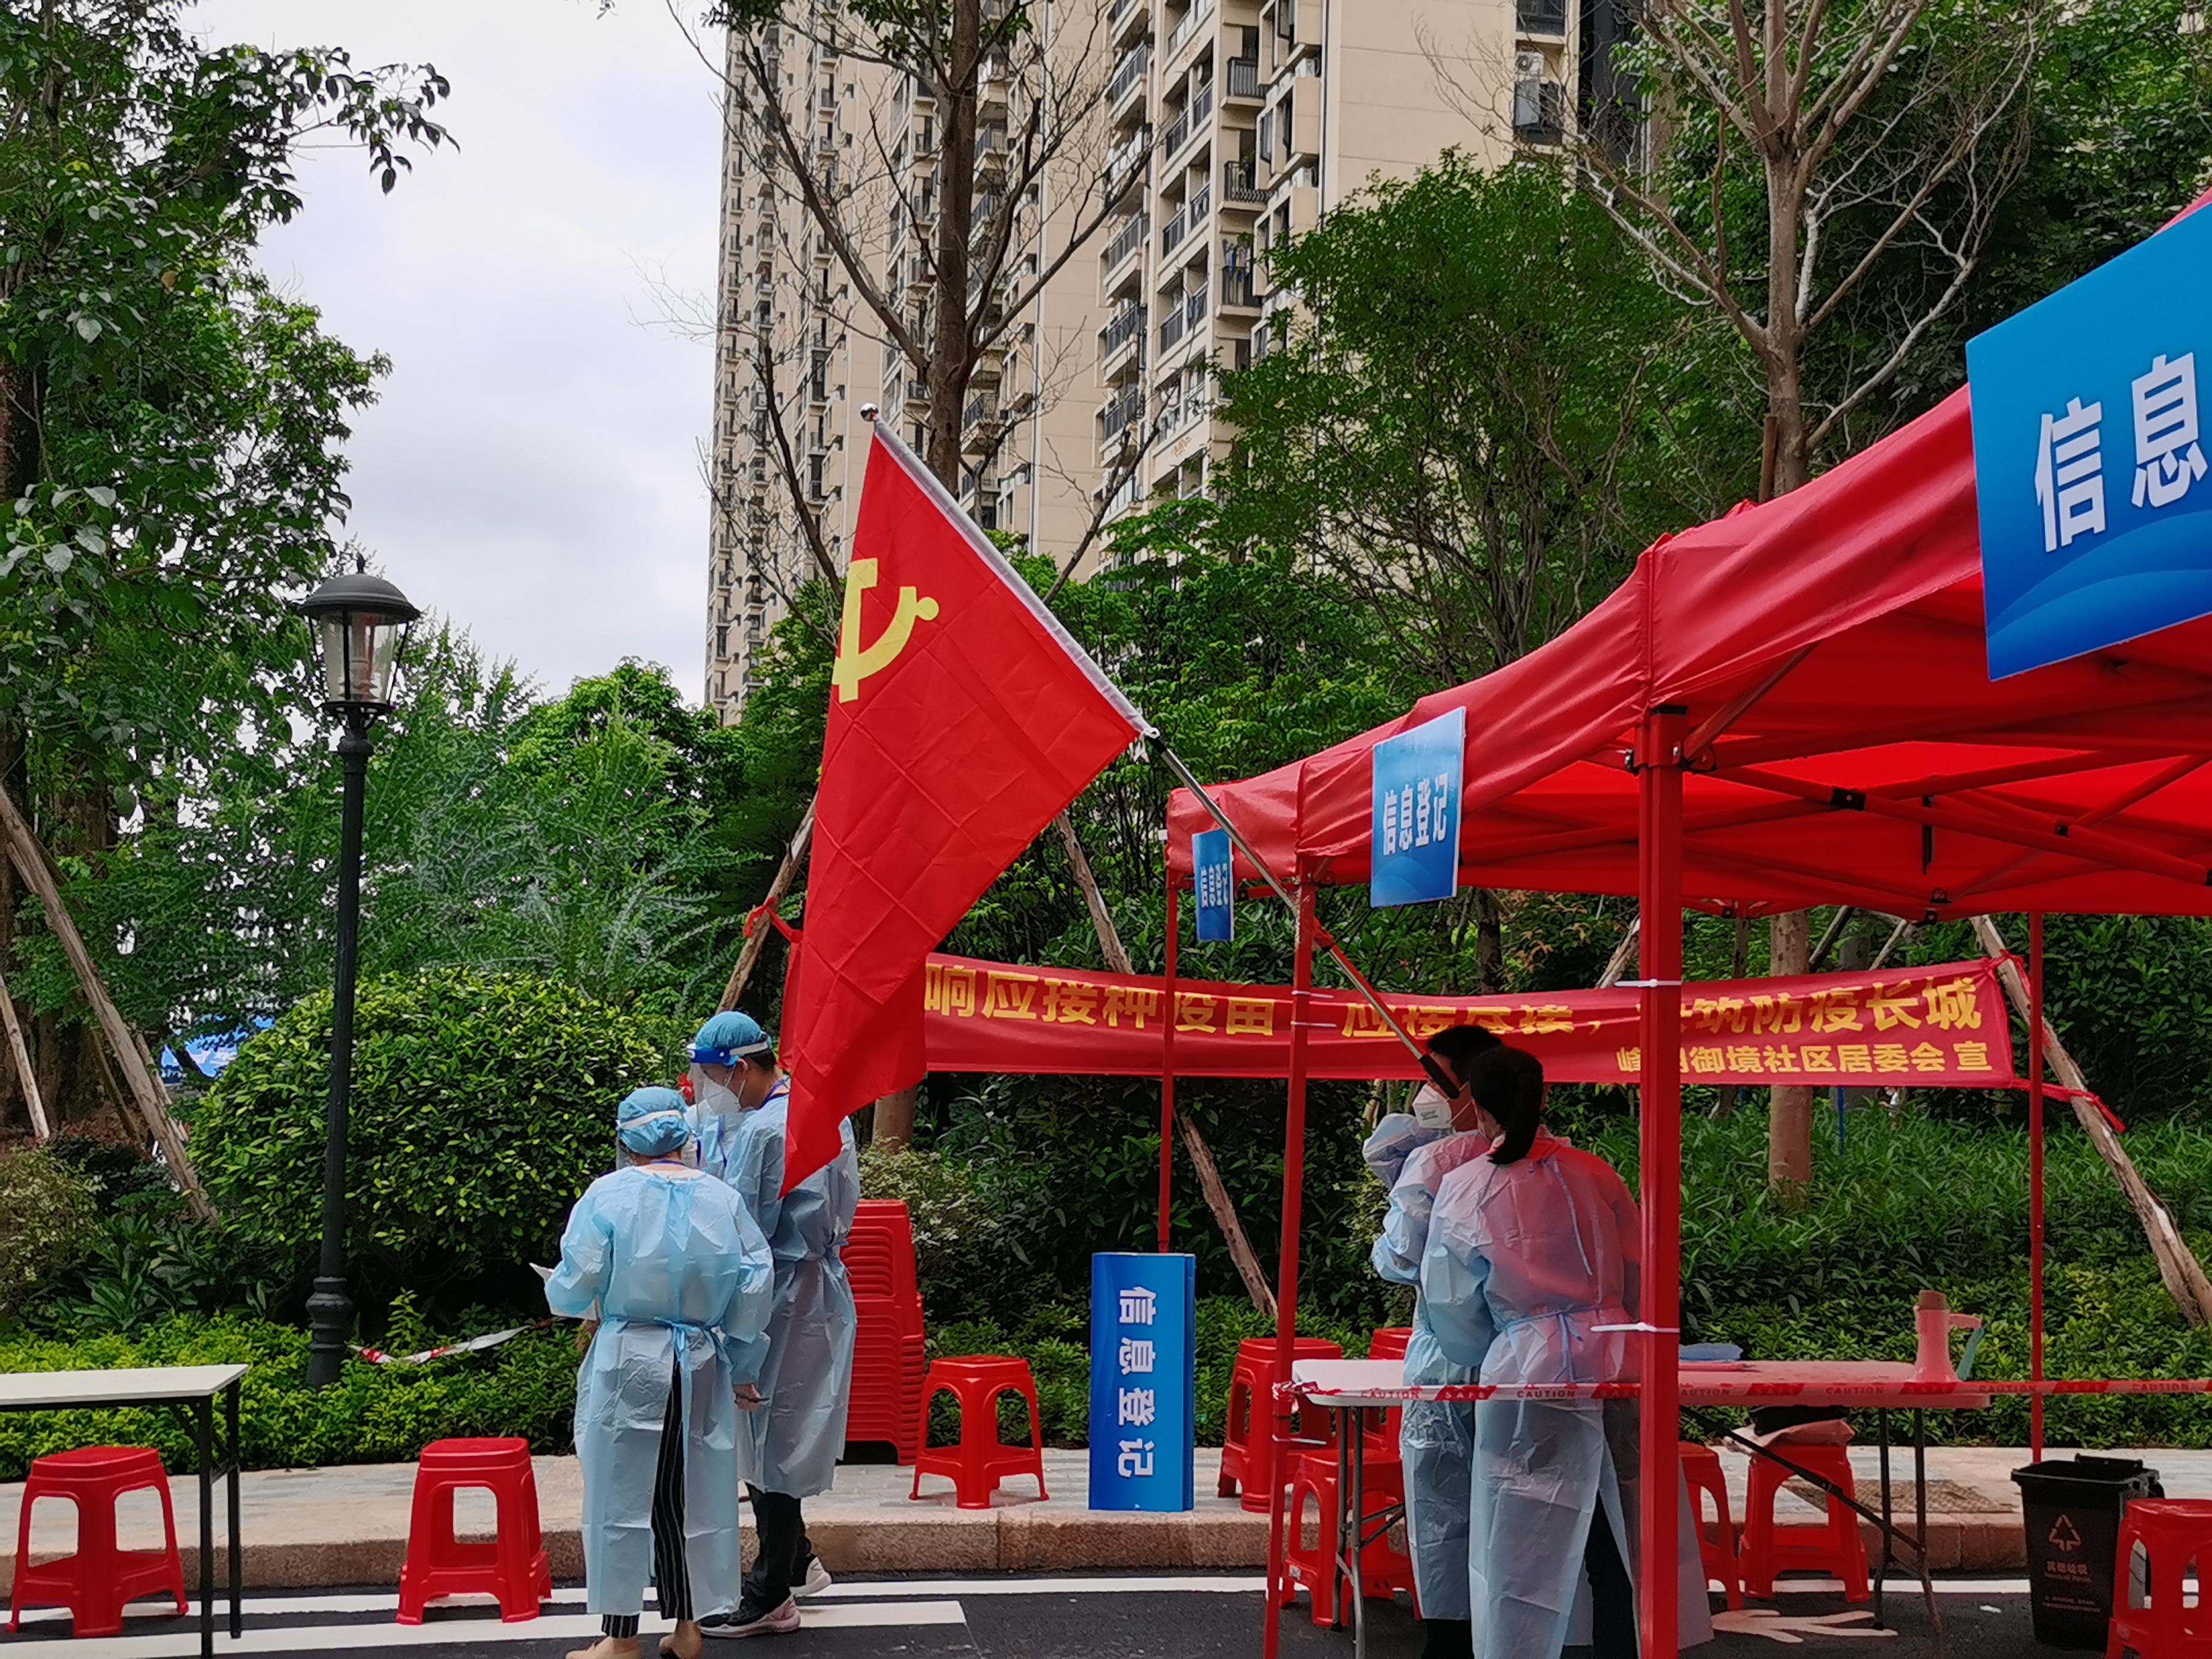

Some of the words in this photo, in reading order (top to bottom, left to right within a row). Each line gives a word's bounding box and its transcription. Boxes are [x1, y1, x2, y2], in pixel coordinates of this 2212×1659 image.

[1382, 772, 1449, 856] 信息登记
[1118, 1285, 1157, 1478] 信息登记
[1517, 1390, 1575, 1398] CAUTION
[2132, 1382, 2190, 1392] CAUTION
